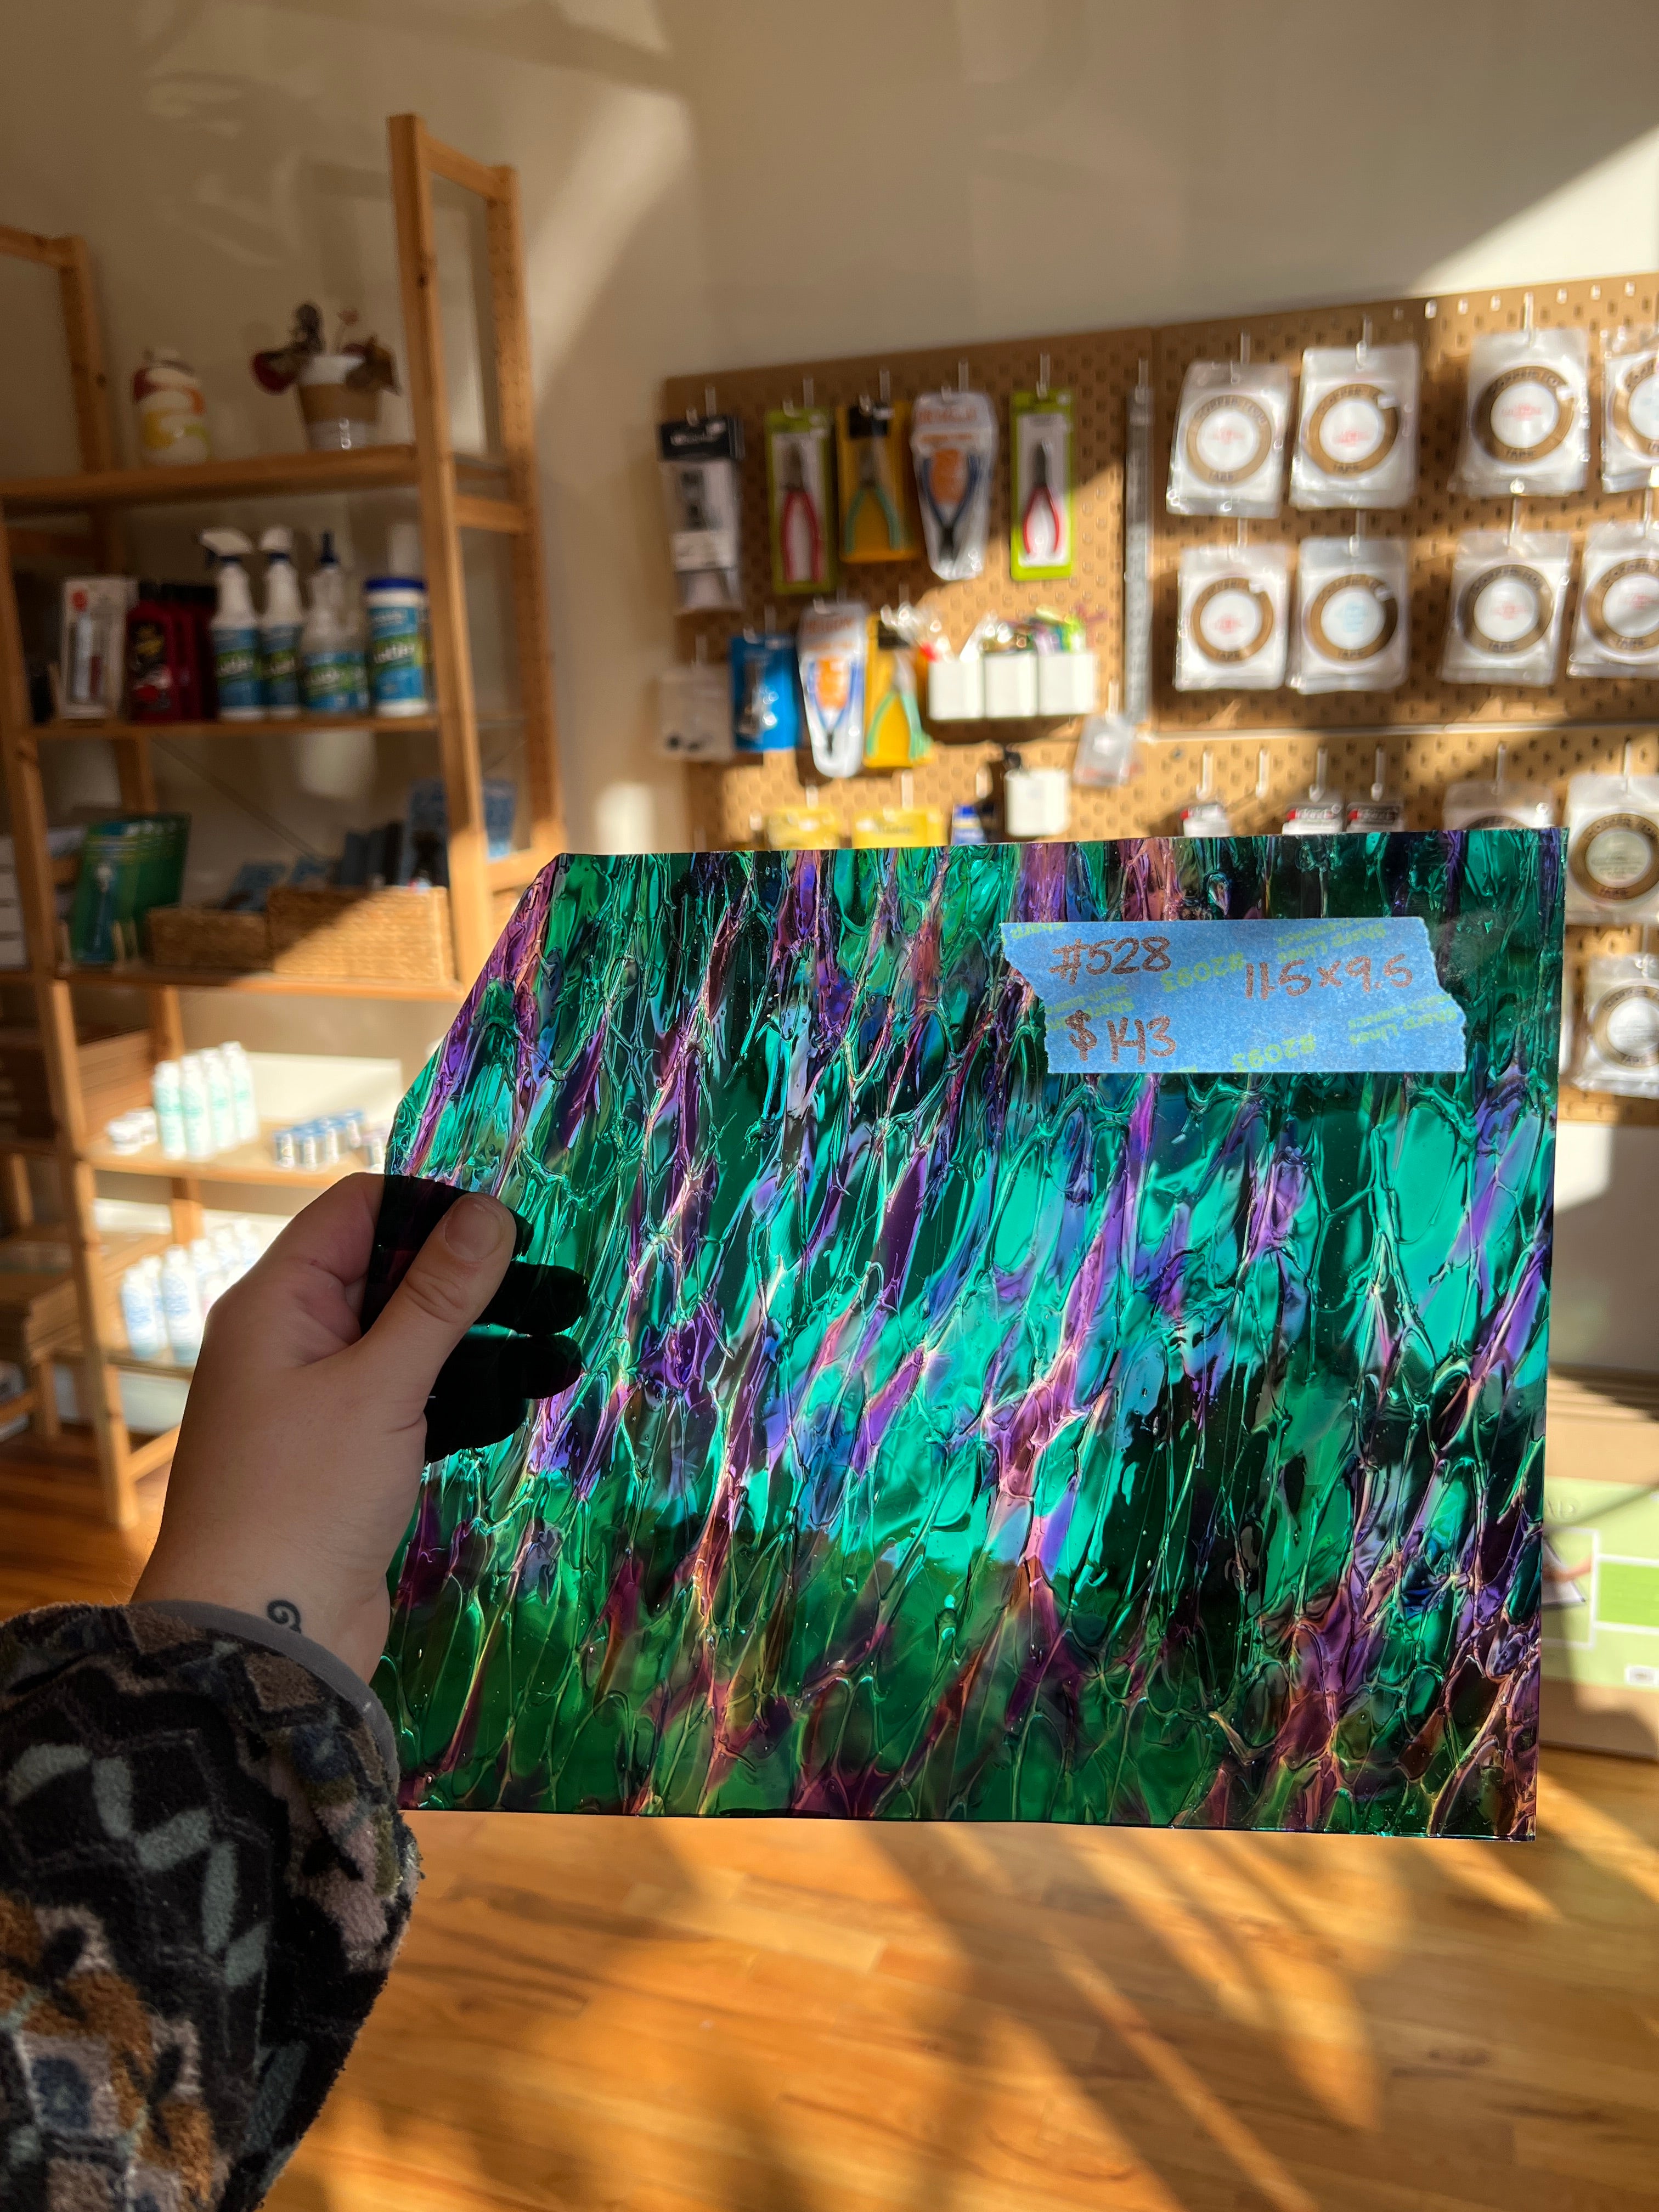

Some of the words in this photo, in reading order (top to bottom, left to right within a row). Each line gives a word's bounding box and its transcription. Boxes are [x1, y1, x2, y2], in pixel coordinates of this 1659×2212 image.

[1048, 936, 1172, 985] #528
[1161, 951, 1245, 992] #2093
[1065, 1009, 1177, 1065] $143
[1232, 1033, 1316, 1072] #2093
